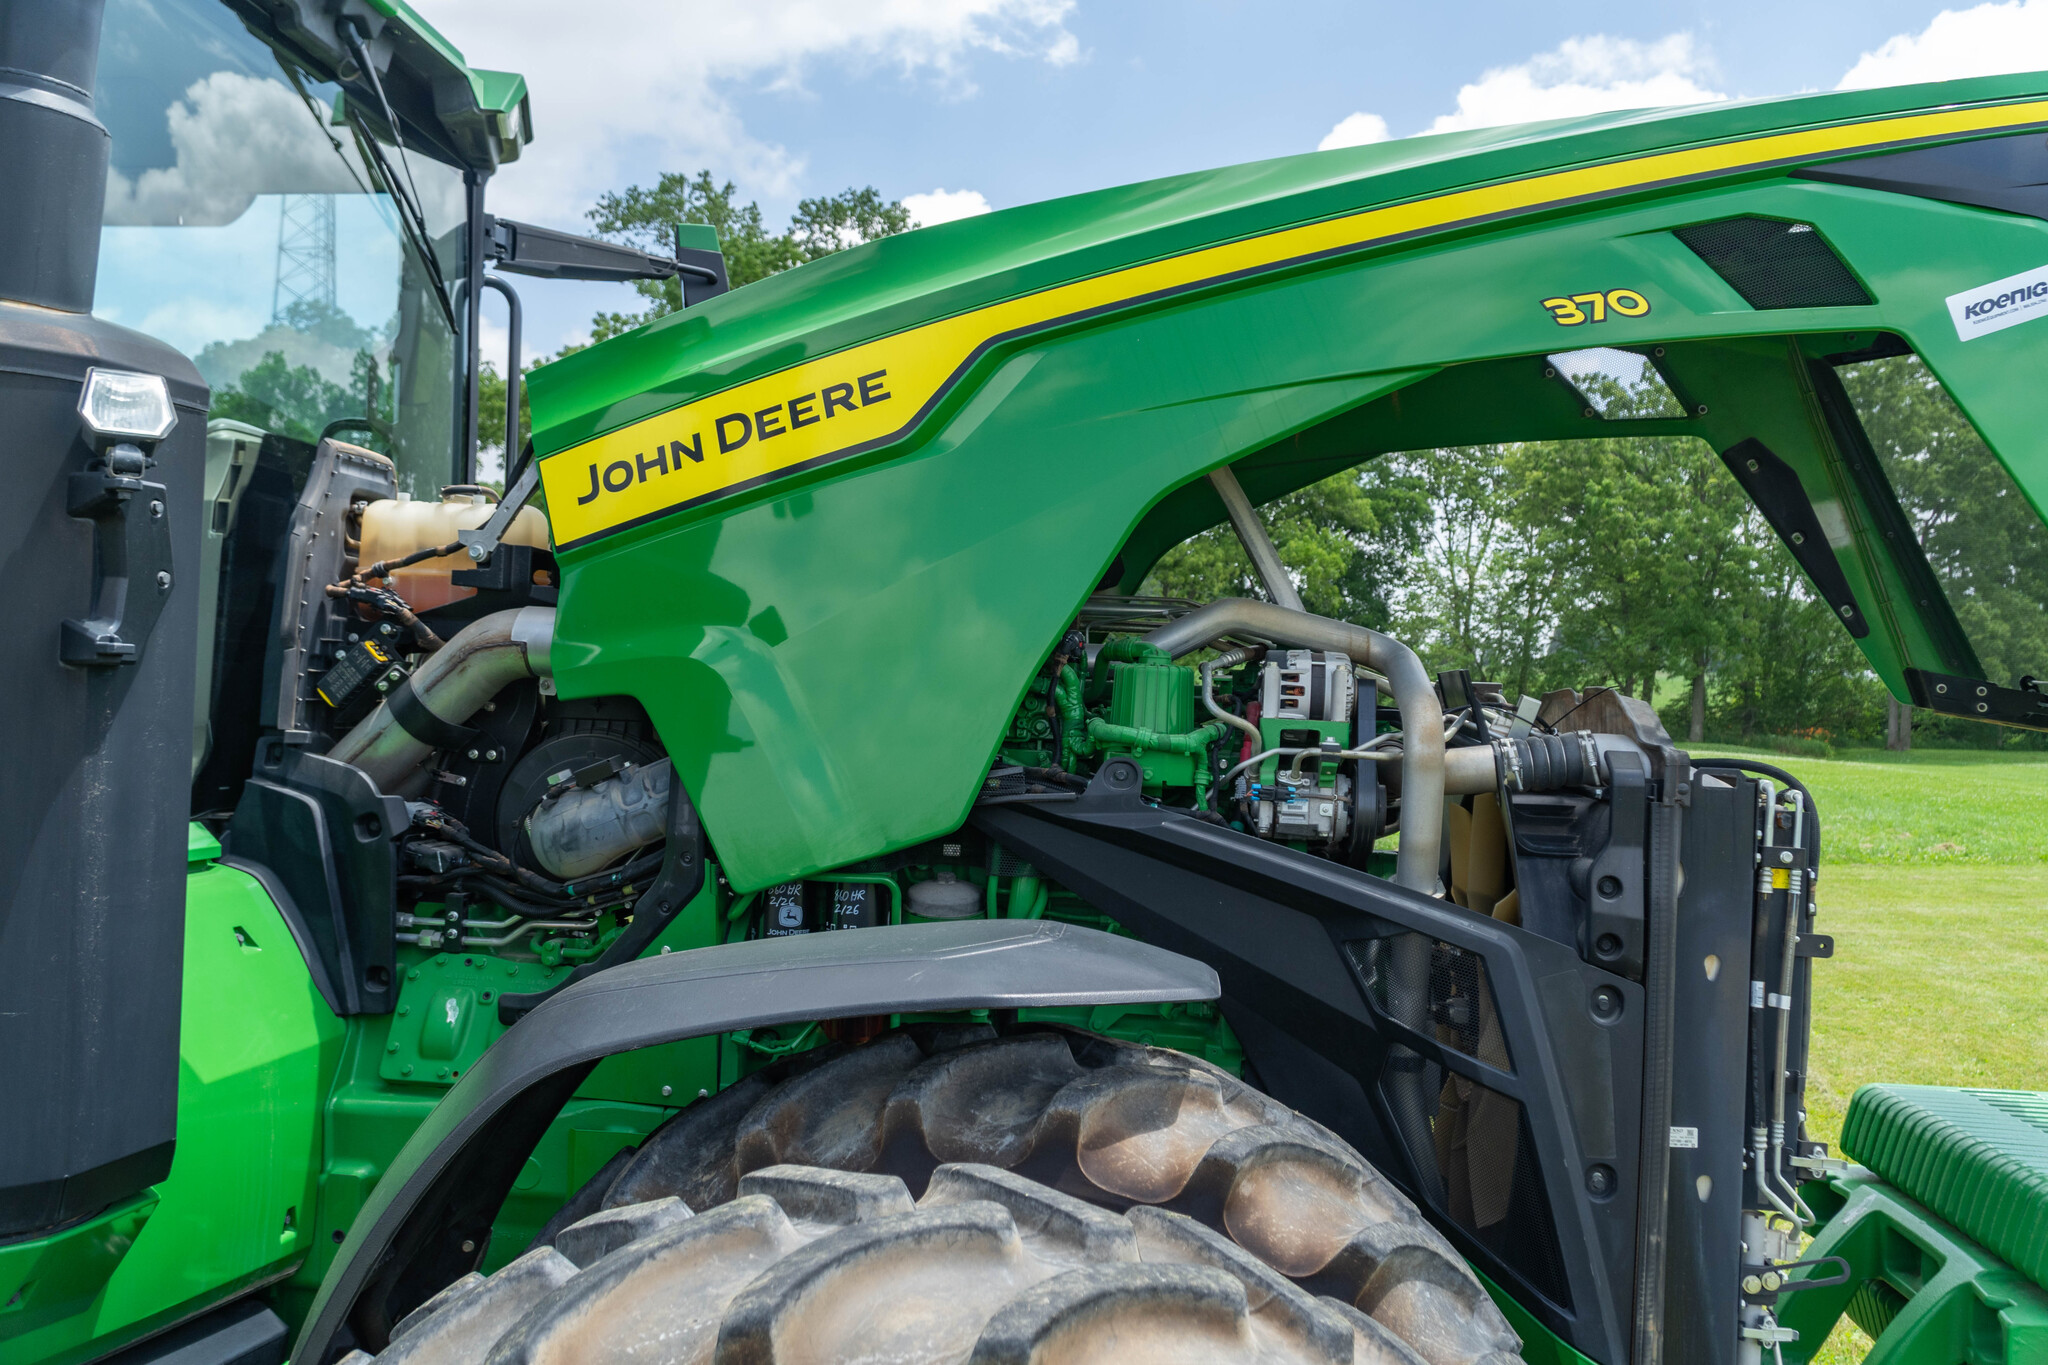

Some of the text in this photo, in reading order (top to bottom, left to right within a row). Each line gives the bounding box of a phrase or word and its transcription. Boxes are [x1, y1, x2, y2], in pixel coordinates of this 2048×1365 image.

[1539, 287, 1652, 327] 370
[577, 368, 892, 506] JOHN DEERE
[787, 883, 802, 896] HR
[850, 889, 866, 902] HR
[769, 896, 796, 907] 2/26
[834, 903, 860, 915] 2/26
[767, 928, 788, 936] JOHN
